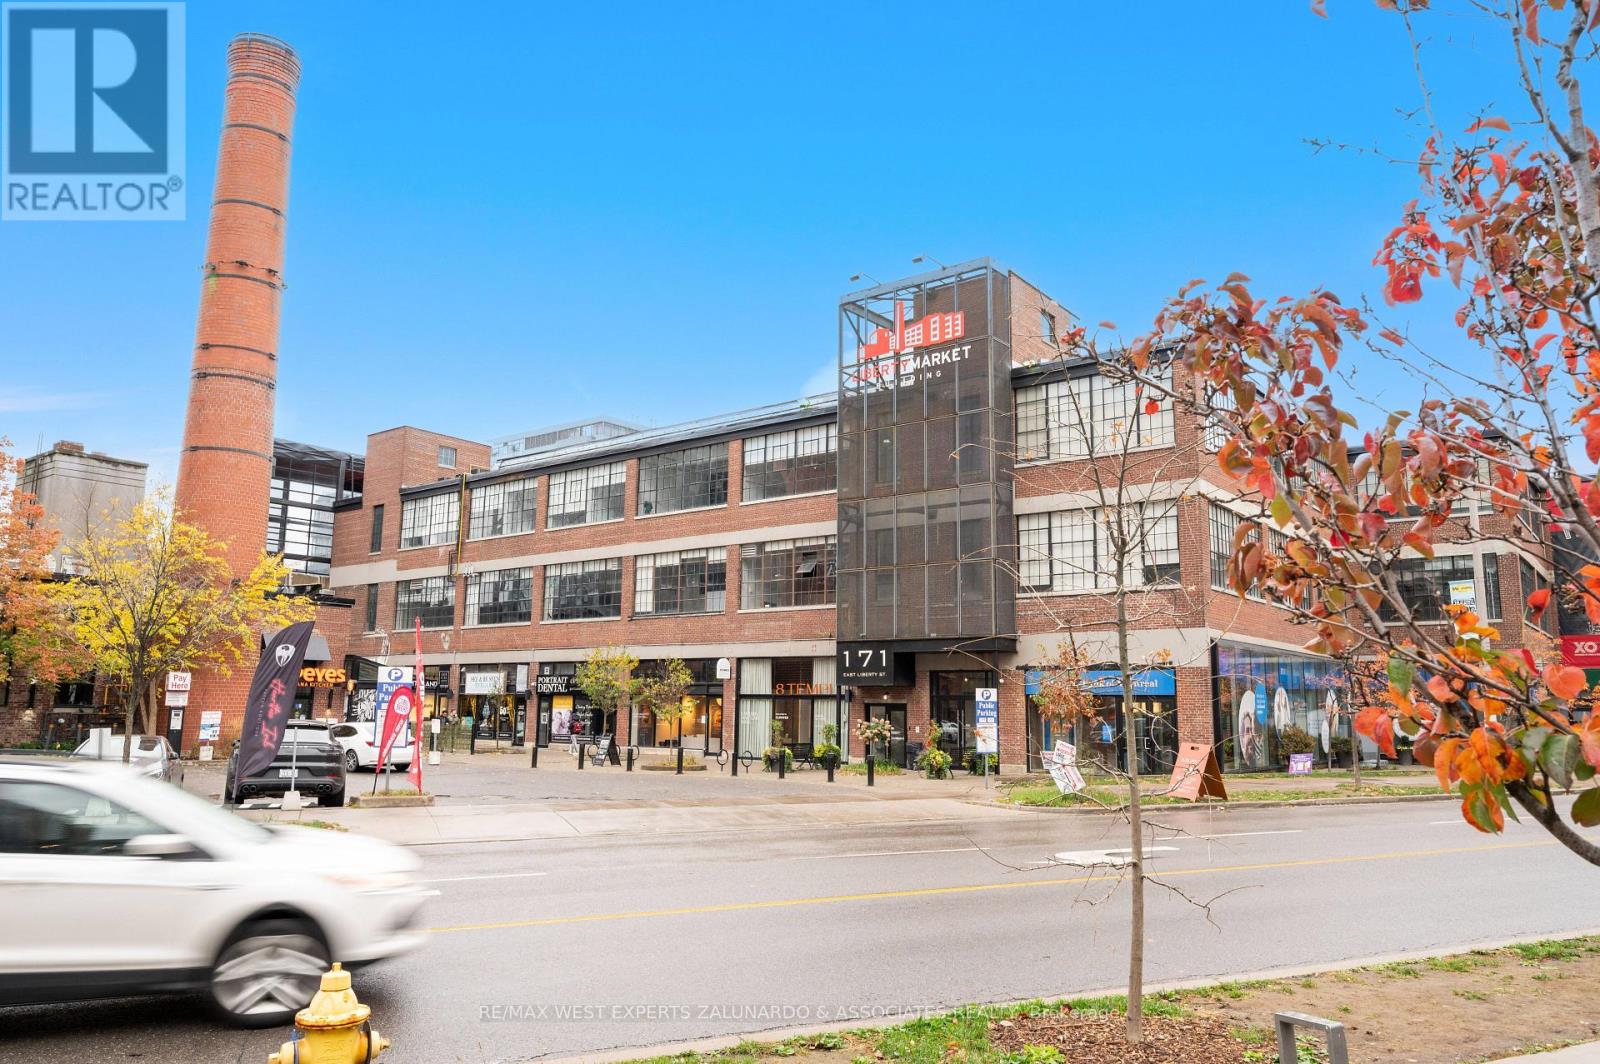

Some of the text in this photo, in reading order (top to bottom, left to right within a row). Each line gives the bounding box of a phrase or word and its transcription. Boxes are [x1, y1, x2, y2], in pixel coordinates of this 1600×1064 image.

[911, 346, 972, 370] MARKET
[842, 649, 886, 667] 171
[174, 674, 188, 683] Pay
[300, 667, 346, 683] eyes
[537, 676, 568, 684] PORTRAIT
[537, 684, 568, 692] DENTAL
[976, 710, 998, 718] Parking
